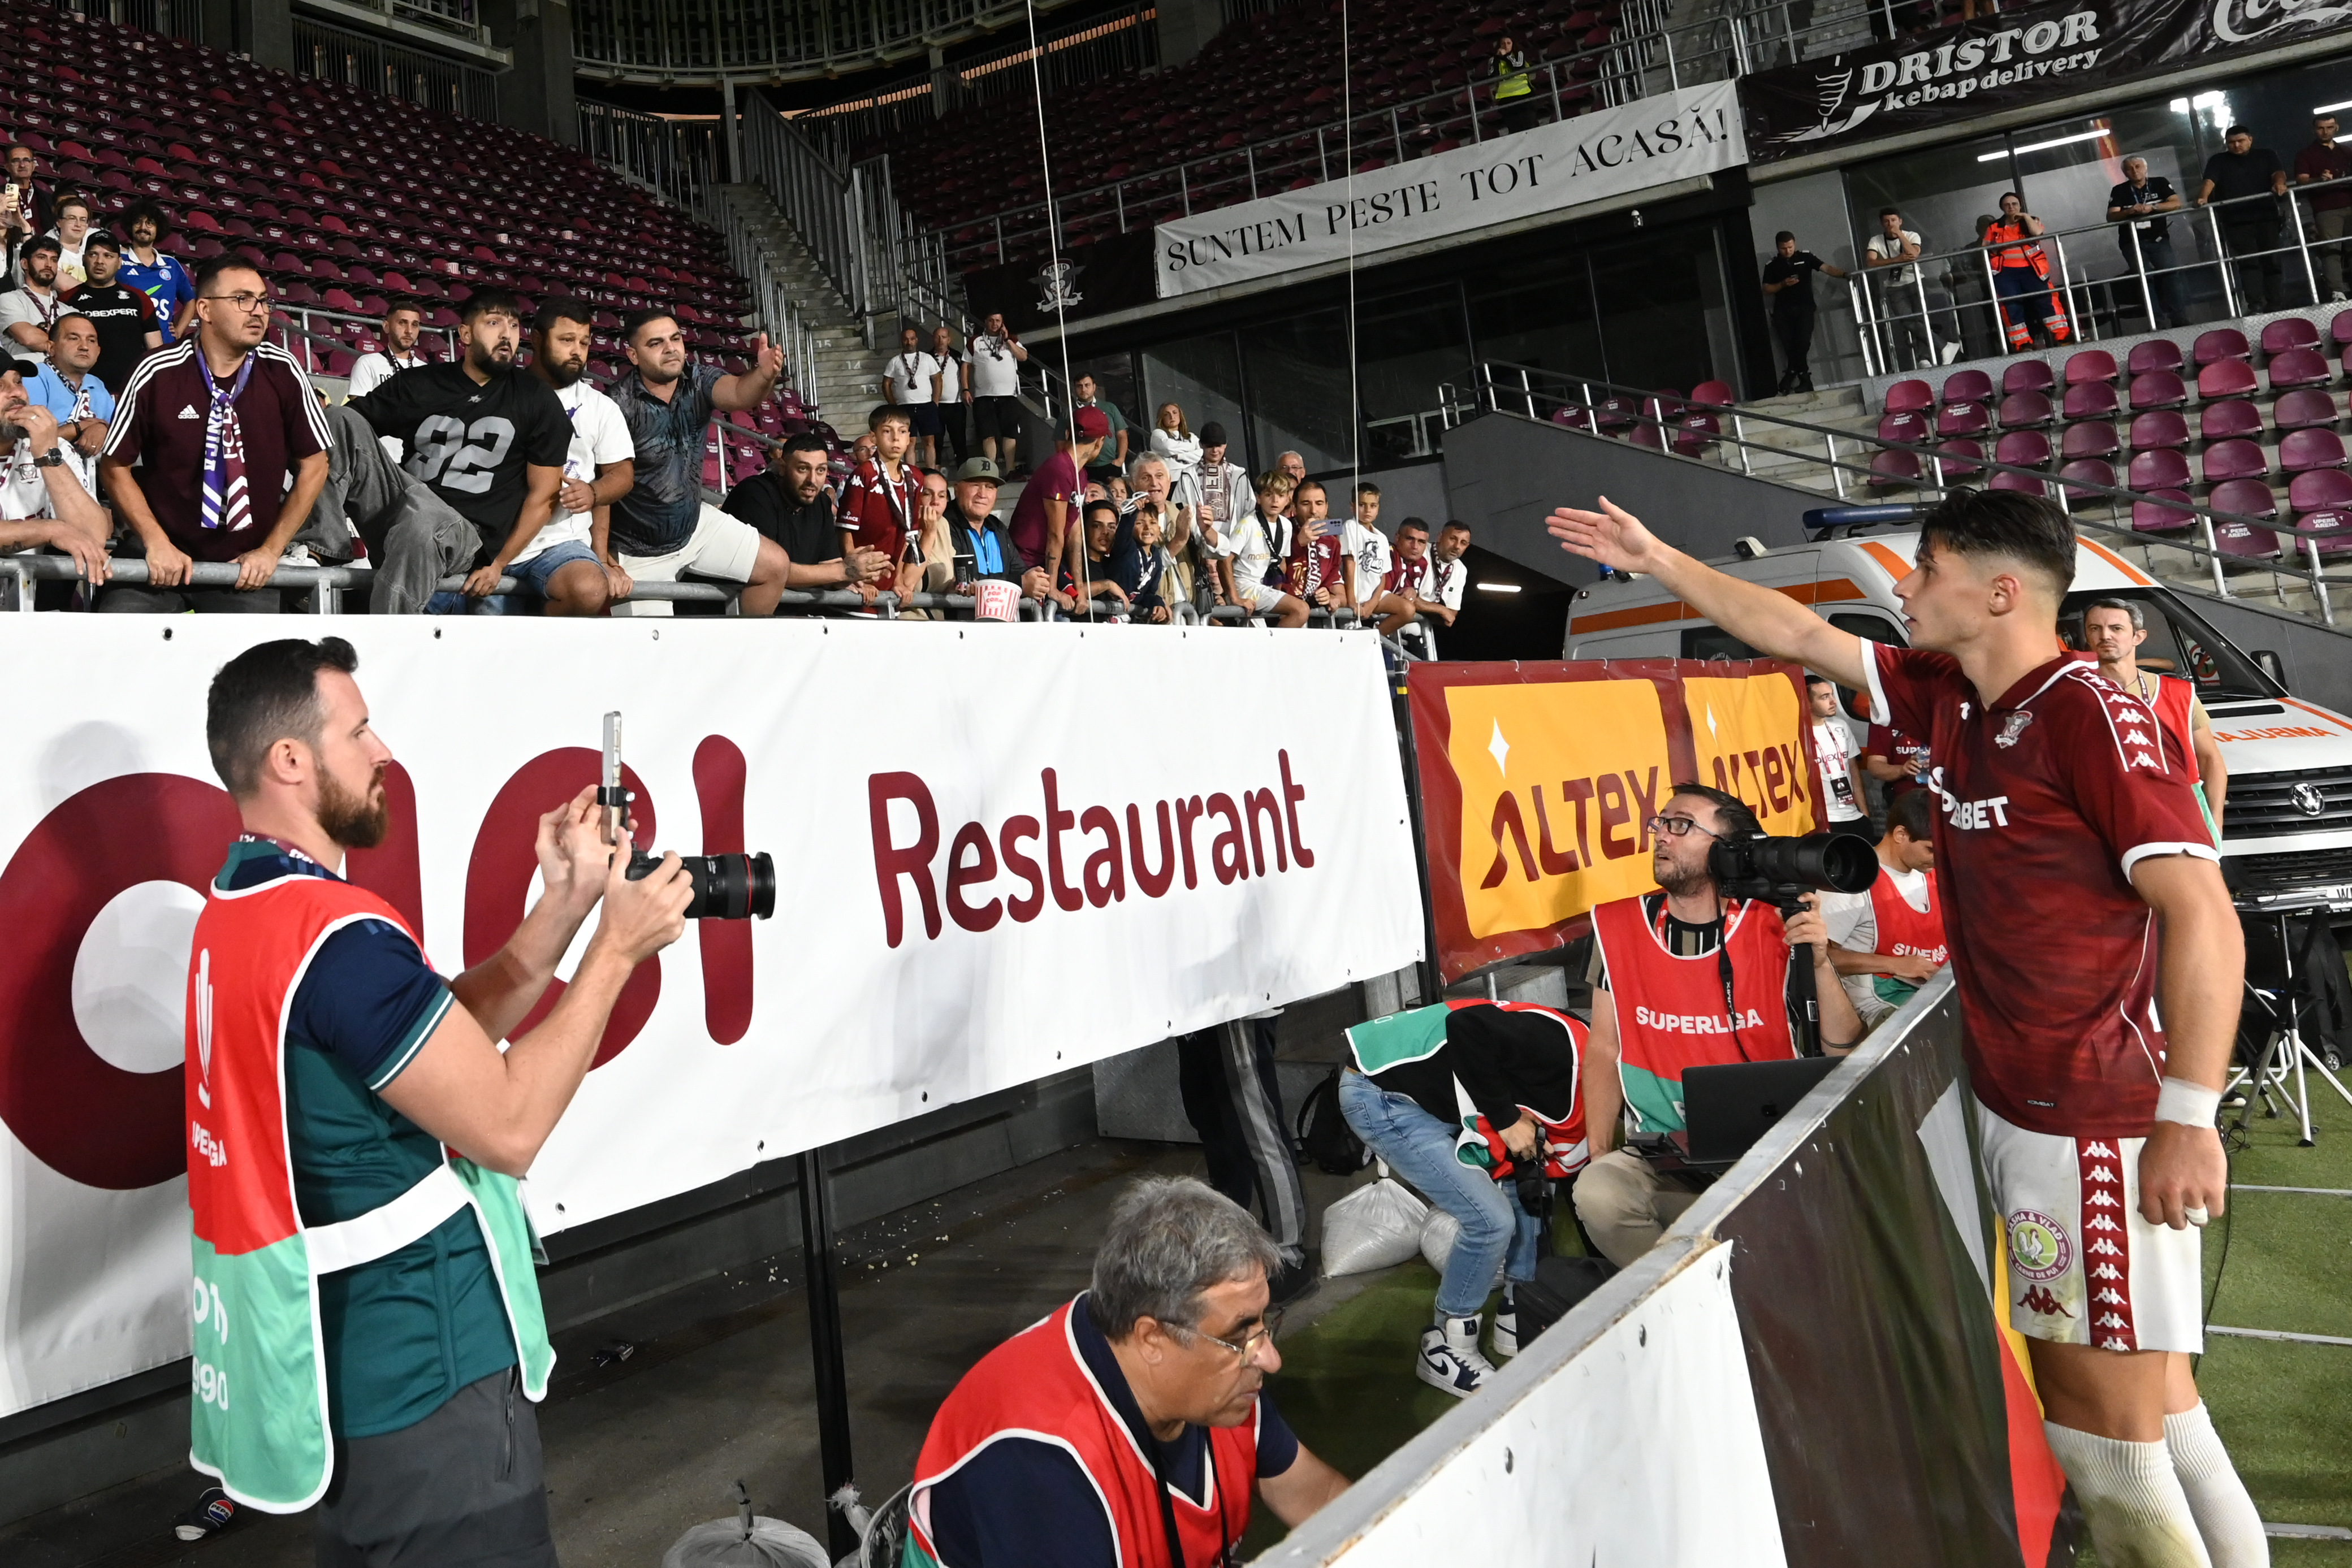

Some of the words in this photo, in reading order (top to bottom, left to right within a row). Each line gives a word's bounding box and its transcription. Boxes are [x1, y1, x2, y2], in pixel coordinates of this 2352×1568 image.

[1858, 11, 2100, 95] DRISTOR
[1883, 78, 1978, 111] kebap
[1980, 49, 2103, 89] delivery
[1167, 214, 1307, 271] SUNTEM
[1326, 181, 1441, 235] PESTE
[1460, 154, 1545, 201] TOT
[1571, 106, 1728, 177] ACASĂ!
[1045, 263, 1067, 275] RAID
[83, 308, 138, 318] OBEXPERT
[845, 361, 862, 370] 14
[861, 384, 878, 394] 13
[404, 414, 515, 493] 92
[868, 748, 1315, 948] Restaurant
[1635, 1005, 1765, 1035] SUPERLIGA
[2007, 1212, 2027, 1233] SASHA
[2028, 1212, 2037, 1222] &
[2039, 1216, 2063, 1240] VLAD
[2014, 1262, 2035, 1278] CARNE
[2046, 1267, 2059, 1277] PUI
